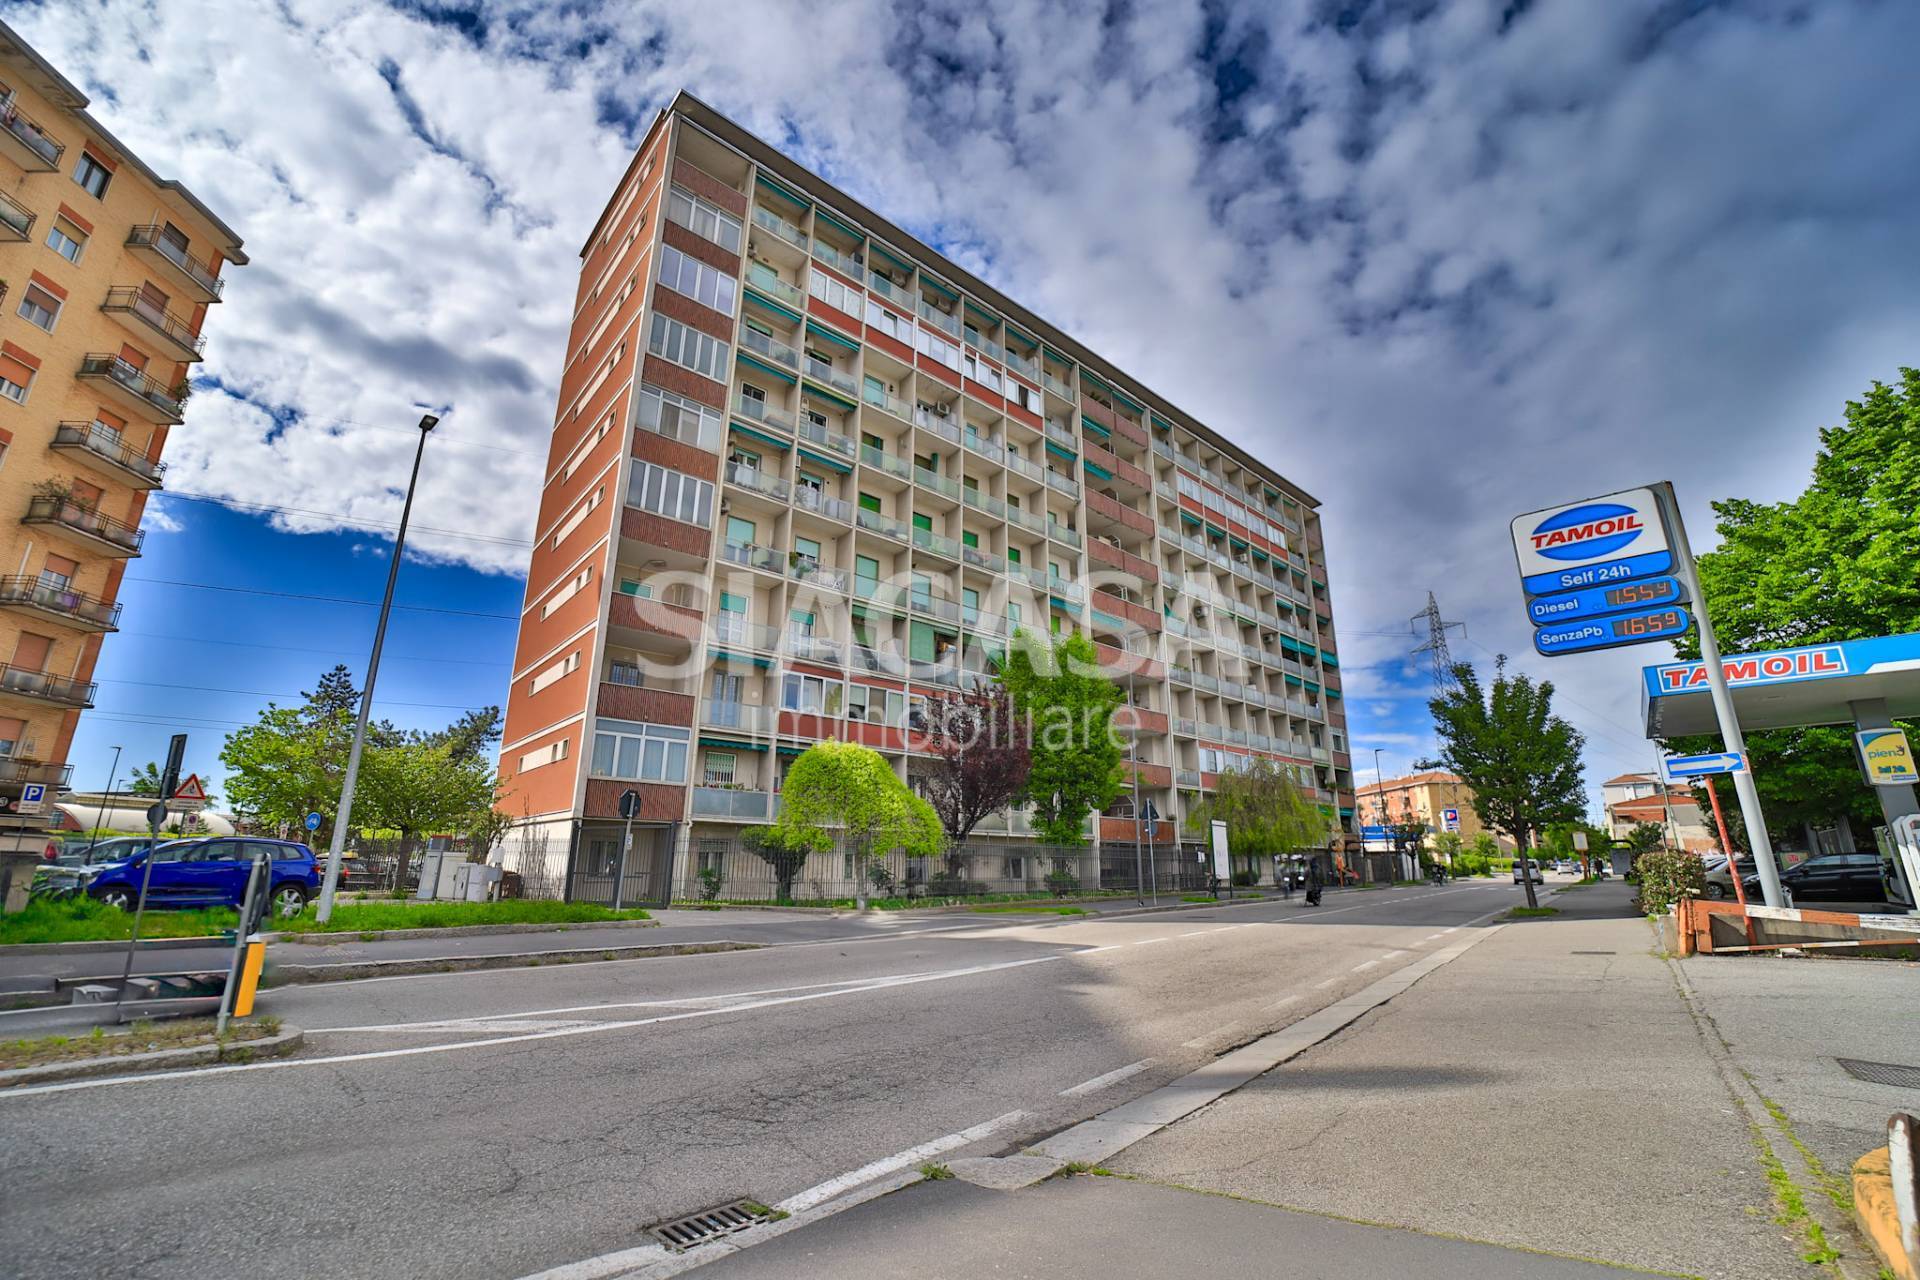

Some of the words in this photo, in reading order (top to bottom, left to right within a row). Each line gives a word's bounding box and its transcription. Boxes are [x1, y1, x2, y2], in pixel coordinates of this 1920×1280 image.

[1531, 516, 1643, 549] TAMOIL
[1561, 570, 1595, 587] Self
[1599, 564, 1631, 580] 24h
[1534, 599, 1579, 615] Diesel
[1541, 626, 1603, 645] SenzaPb
[1664, 652, 1840, 688] TAMOIL
[27, 787, 40, 800] P
